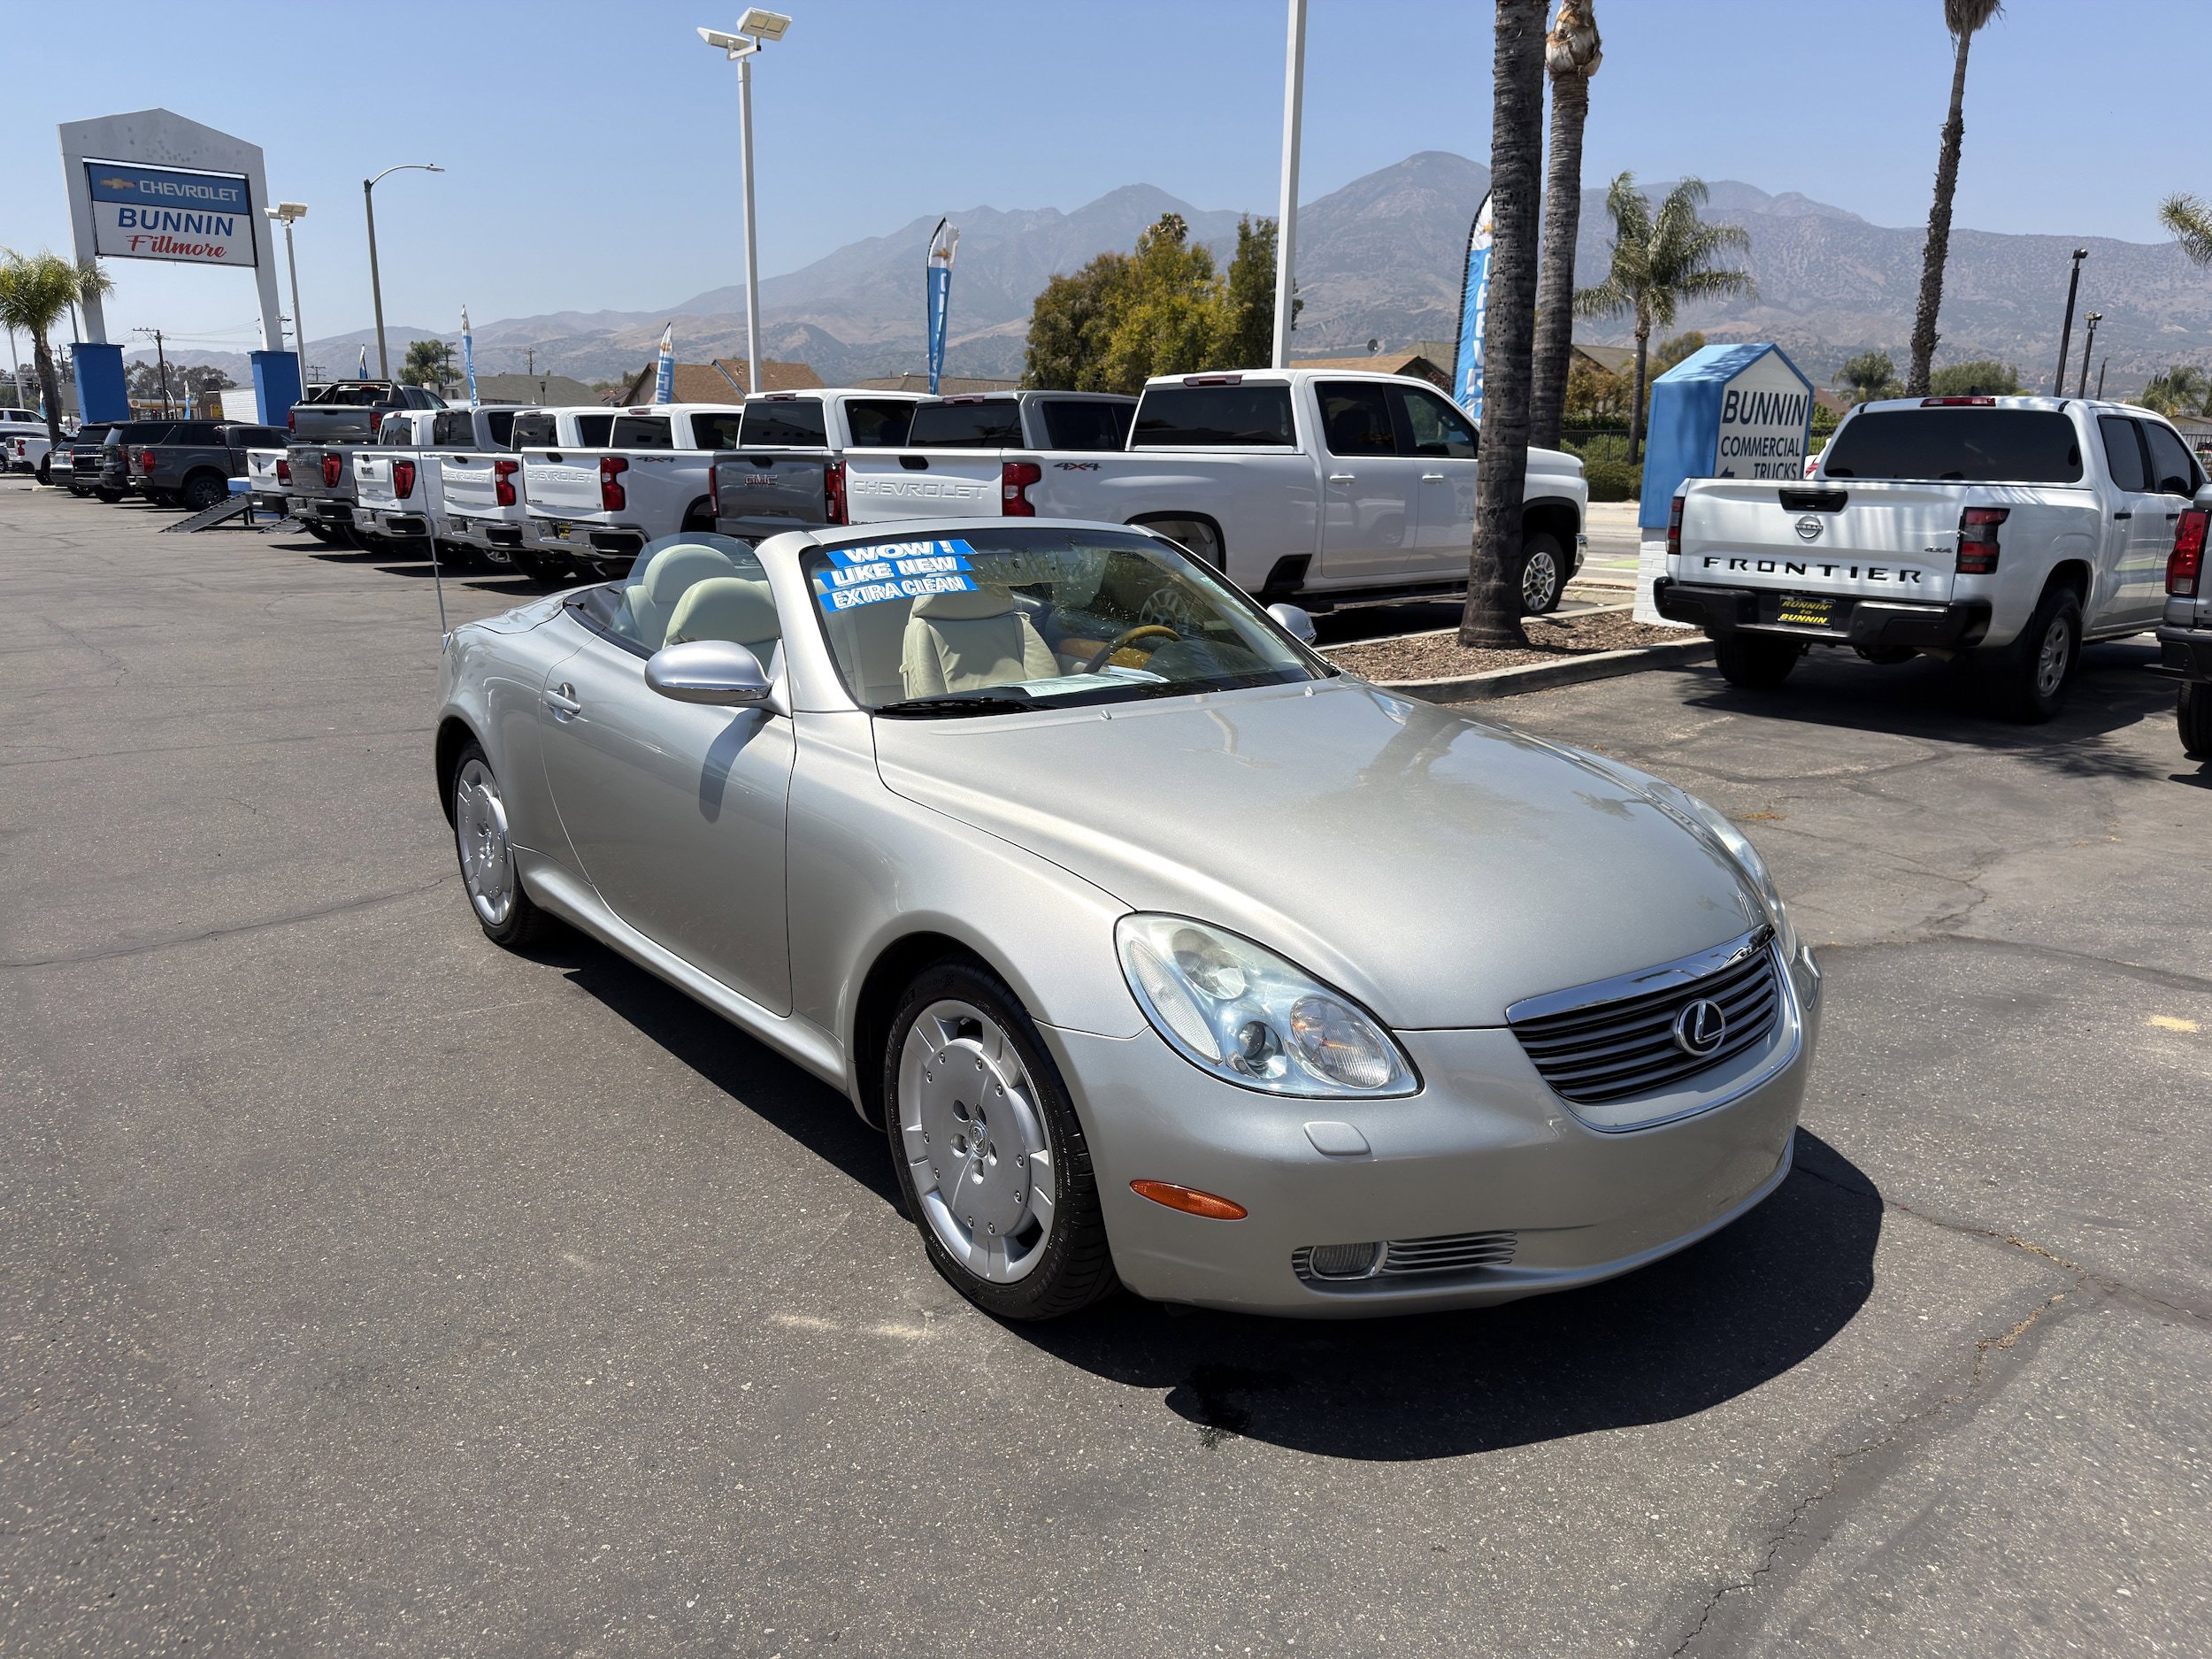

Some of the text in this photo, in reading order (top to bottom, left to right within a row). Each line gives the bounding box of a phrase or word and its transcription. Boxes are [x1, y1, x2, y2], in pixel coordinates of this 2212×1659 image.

[139, 180, 239, 202] CHEVROLET
[118, 207, 234, 237] BUNNIN
[126, 234, 227, 258] Fillmore
[1722, 389, 1808, 426] BUNNIN
[1720, 436, 1801, 457] COMMERCIAL
[526, 470, 593, 484] CHEVROLET
[744, 474, 778, 487] GMC
[1754, 463, 1798, 479] TRUCKS
[853, 480, 989, 500] CHEVROLET
[831, 556, 958, 587] LIKE NEW
[1703, 557, 1922, 583] FRONTIER
[833, 576, 968, 610] EXTRA CLEAN
[1779, 613, 1828, 624] BUNNIN
